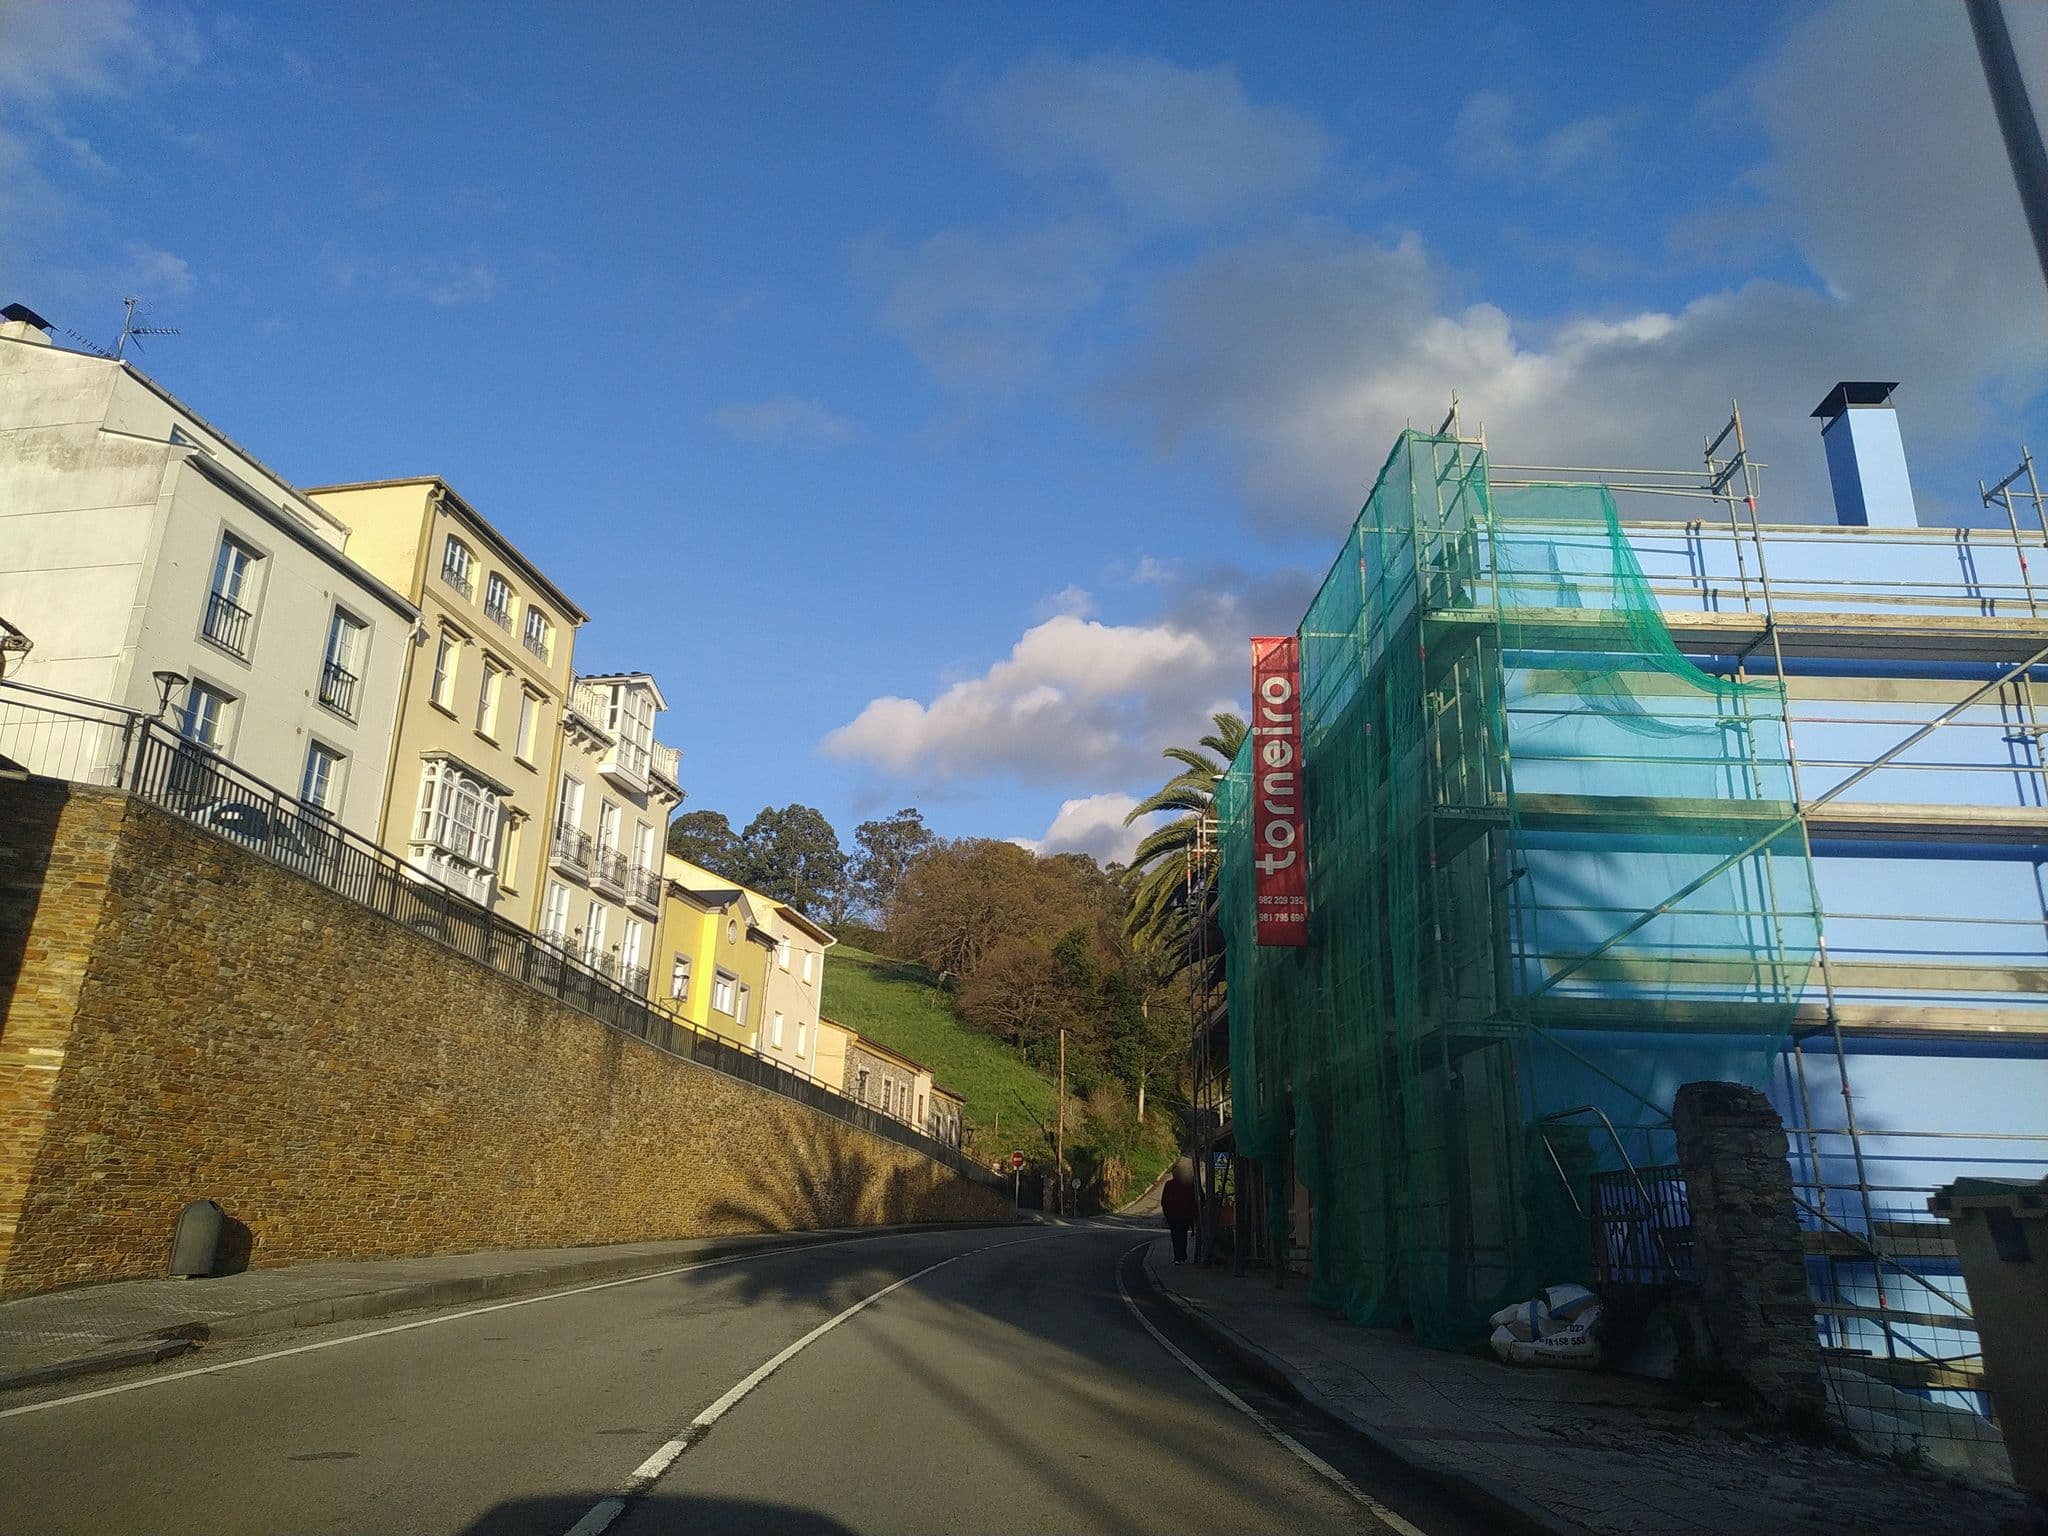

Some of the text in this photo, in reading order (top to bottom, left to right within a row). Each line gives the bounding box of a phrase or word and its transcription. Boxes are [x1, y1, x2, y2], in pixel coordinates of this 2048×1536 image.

[1253, 676, 1297, 875] torneiro
[1258, 895, 1273, 905] 982
[1258, 913, 1273, 922] 981
[1274, 913, 1289, 922] 795
